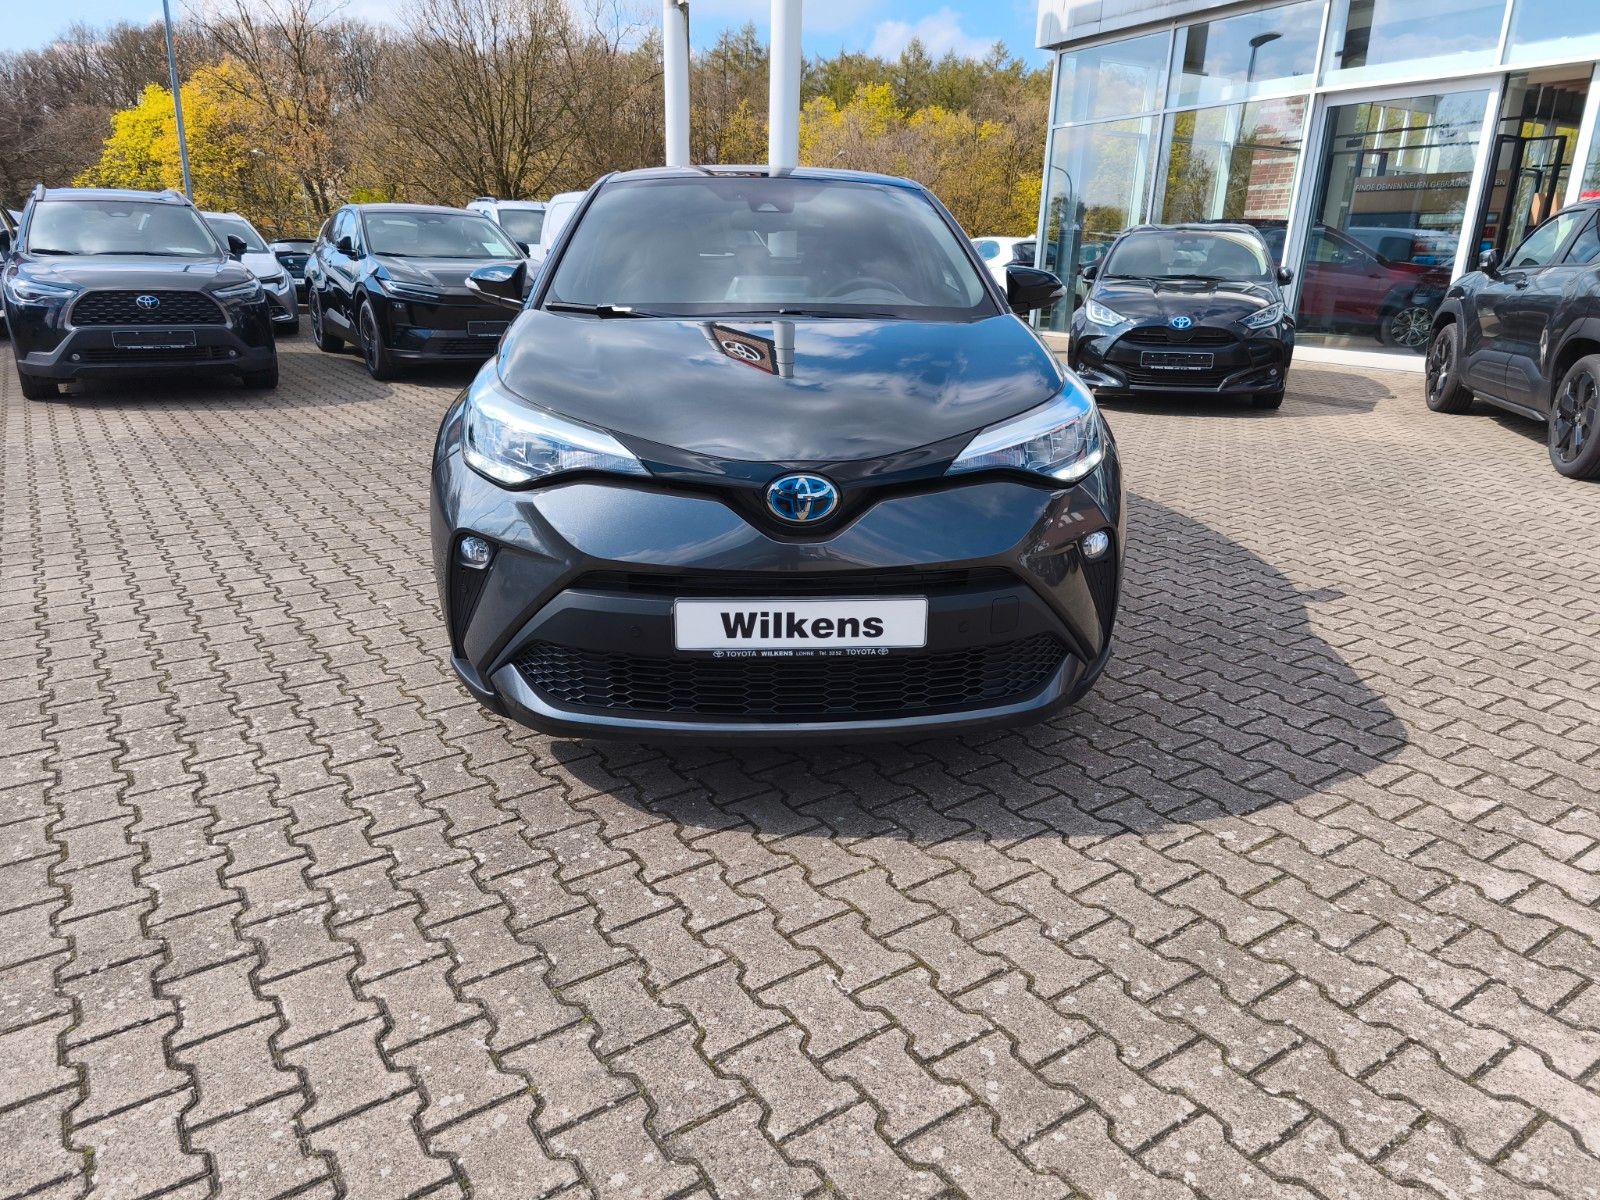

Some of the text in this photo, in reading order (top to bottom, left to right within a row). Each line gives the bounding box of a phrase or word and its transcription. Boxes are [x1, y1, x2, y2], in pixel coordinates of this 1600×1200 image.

[1404, 181, 1430, 189] NEUEN
[720, 611, 884, 639] Wilkens
[726, 650, 757, 658] TOYOTA
[846, 648, 877, 656] TOYOTA
